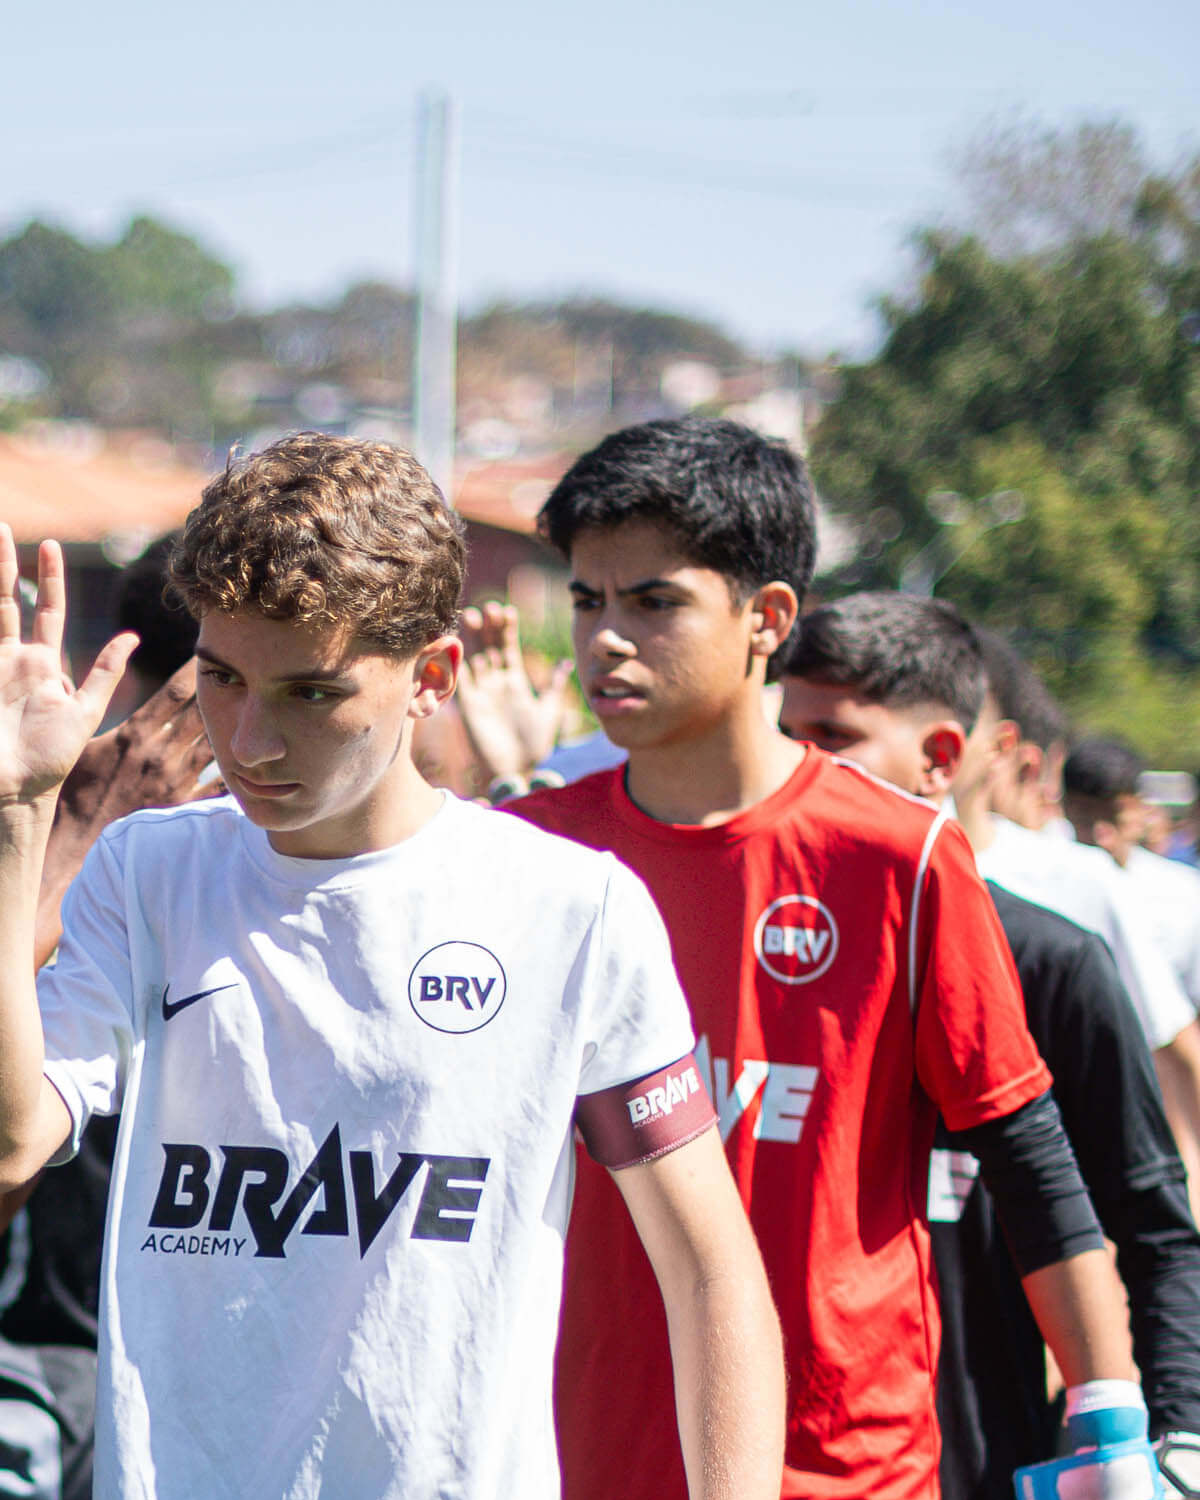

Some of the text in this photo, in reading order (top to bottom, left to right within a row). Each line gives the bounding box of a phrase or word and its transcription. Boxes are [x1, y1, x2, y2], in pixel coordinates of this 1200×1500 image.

[763, 926, 830, 963] BRV
[418, 975, 497, 1011] BRV
[626, 1066, 699, 1124] BRAVE
[148, 1121, 492, 1260] BRAVE
[140, 1234, 248, 1257] ACADEMY
